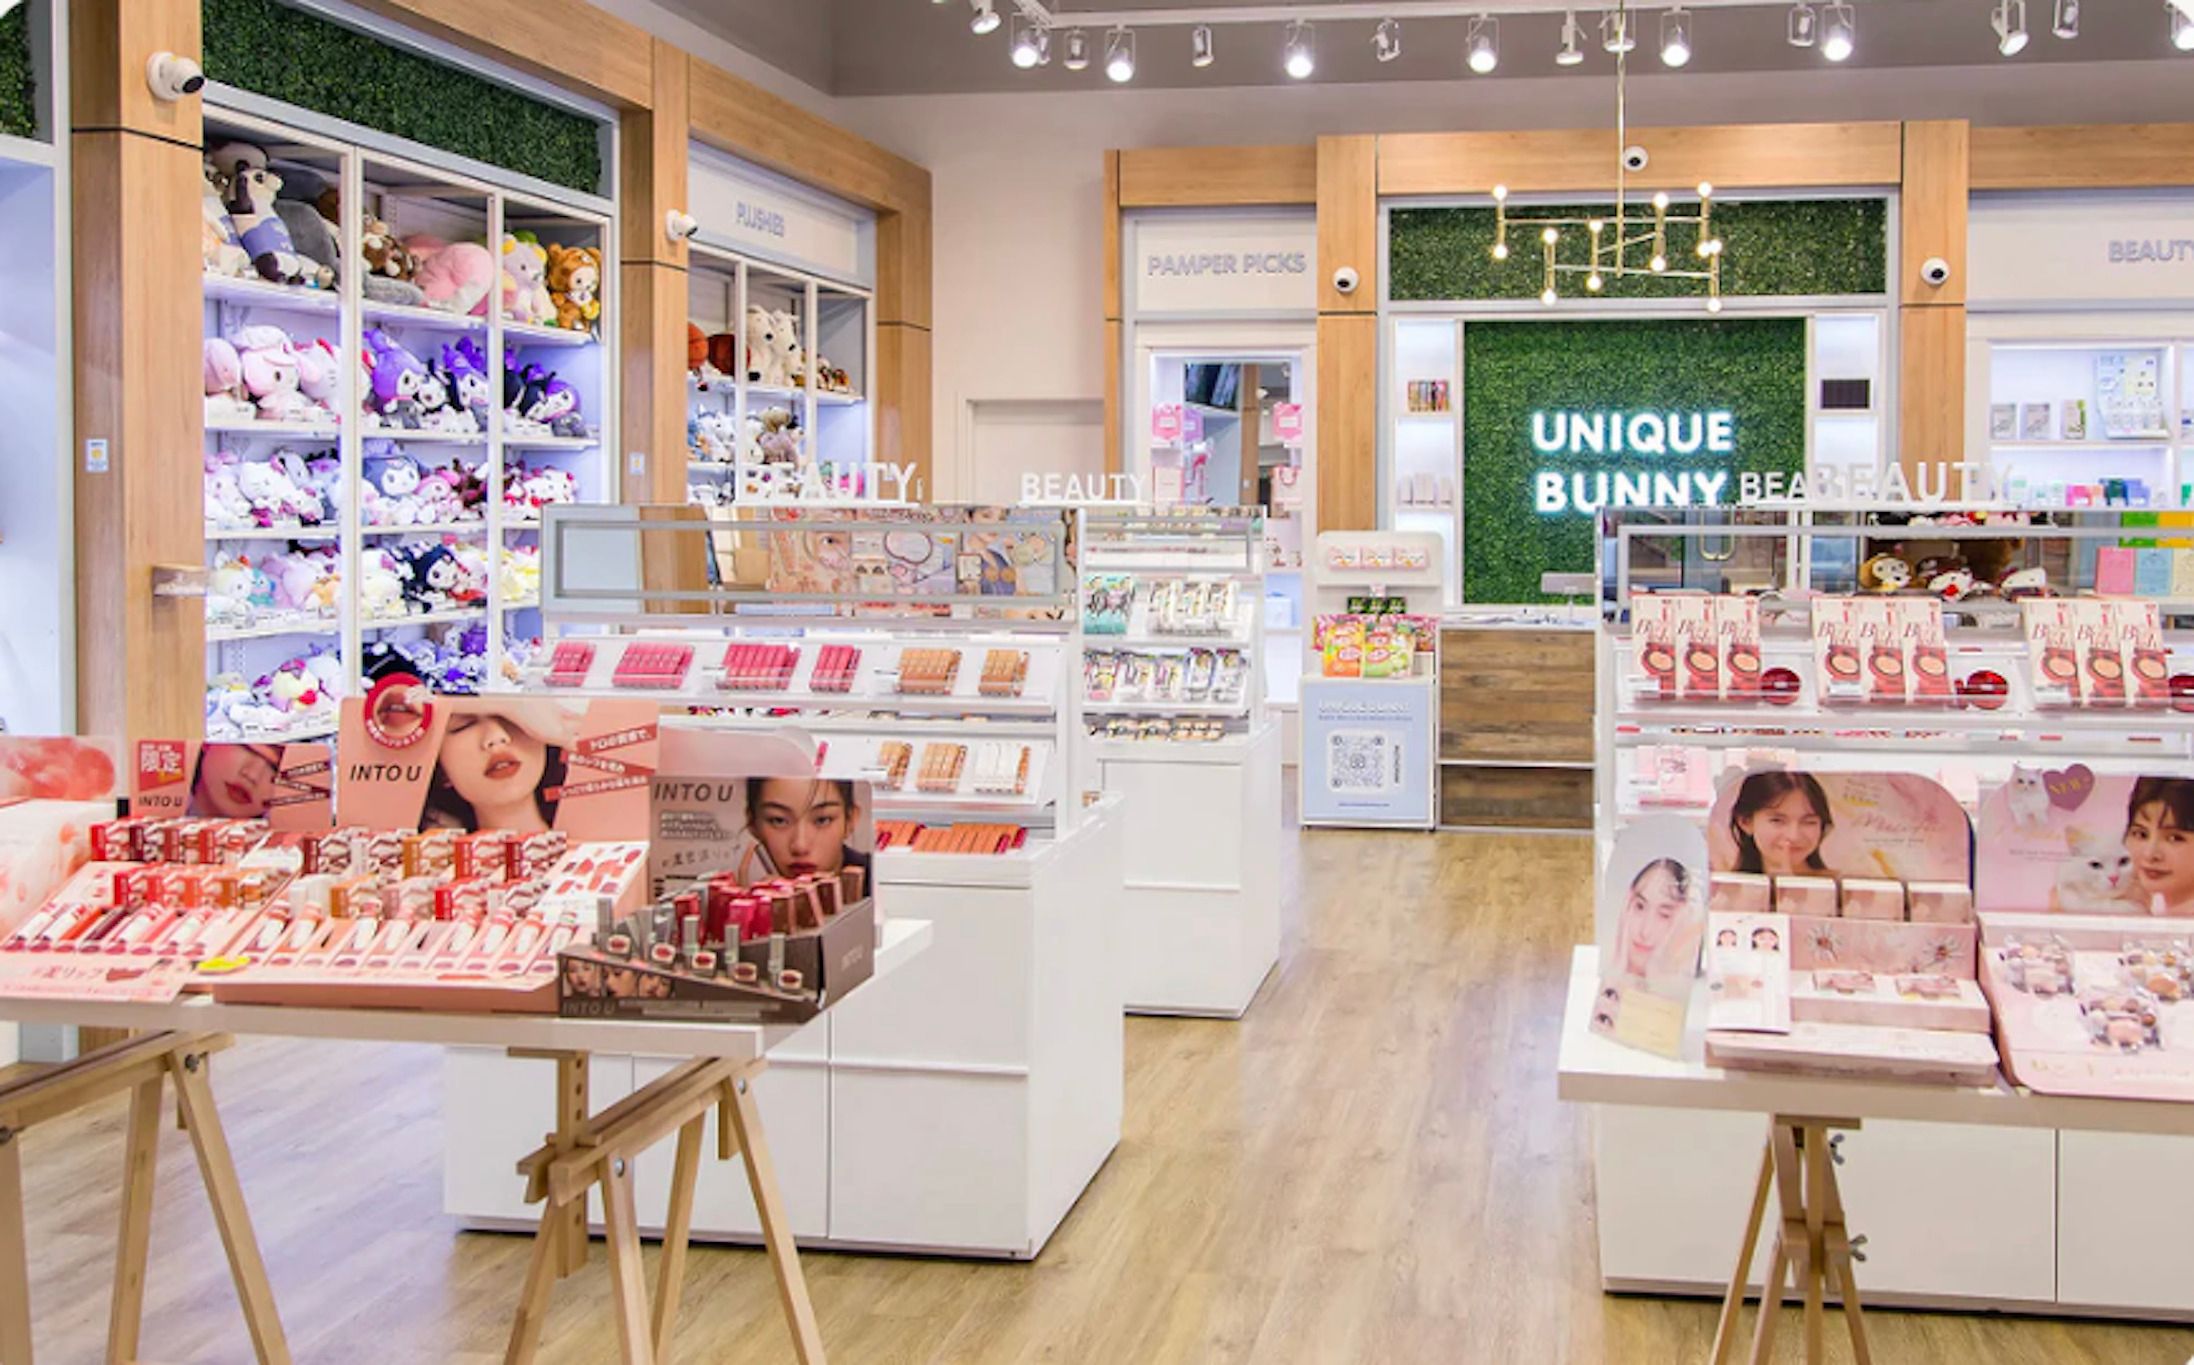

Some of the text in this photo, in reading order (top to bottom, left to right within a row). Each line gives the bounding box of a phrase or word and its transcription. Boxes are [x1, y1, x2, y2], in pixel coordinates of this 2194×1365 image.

[2108, 239, 2194, 262] BEAUT
[1147, 251, 1308, 276] PAMPER PICKS
[1532, 411, 1733, 454] UNIQUE
[1021, 472, 1147, 501] BEAUTY
[1535, 470, 1728, 515] BUNNY
[349, 764, 402, 782] INTO
[406, 764, 423, 782] U
[138, 796, 183, 807] INTO U
[654, 783, 711, 802] INTO
[717, 783, 734, 802] U
